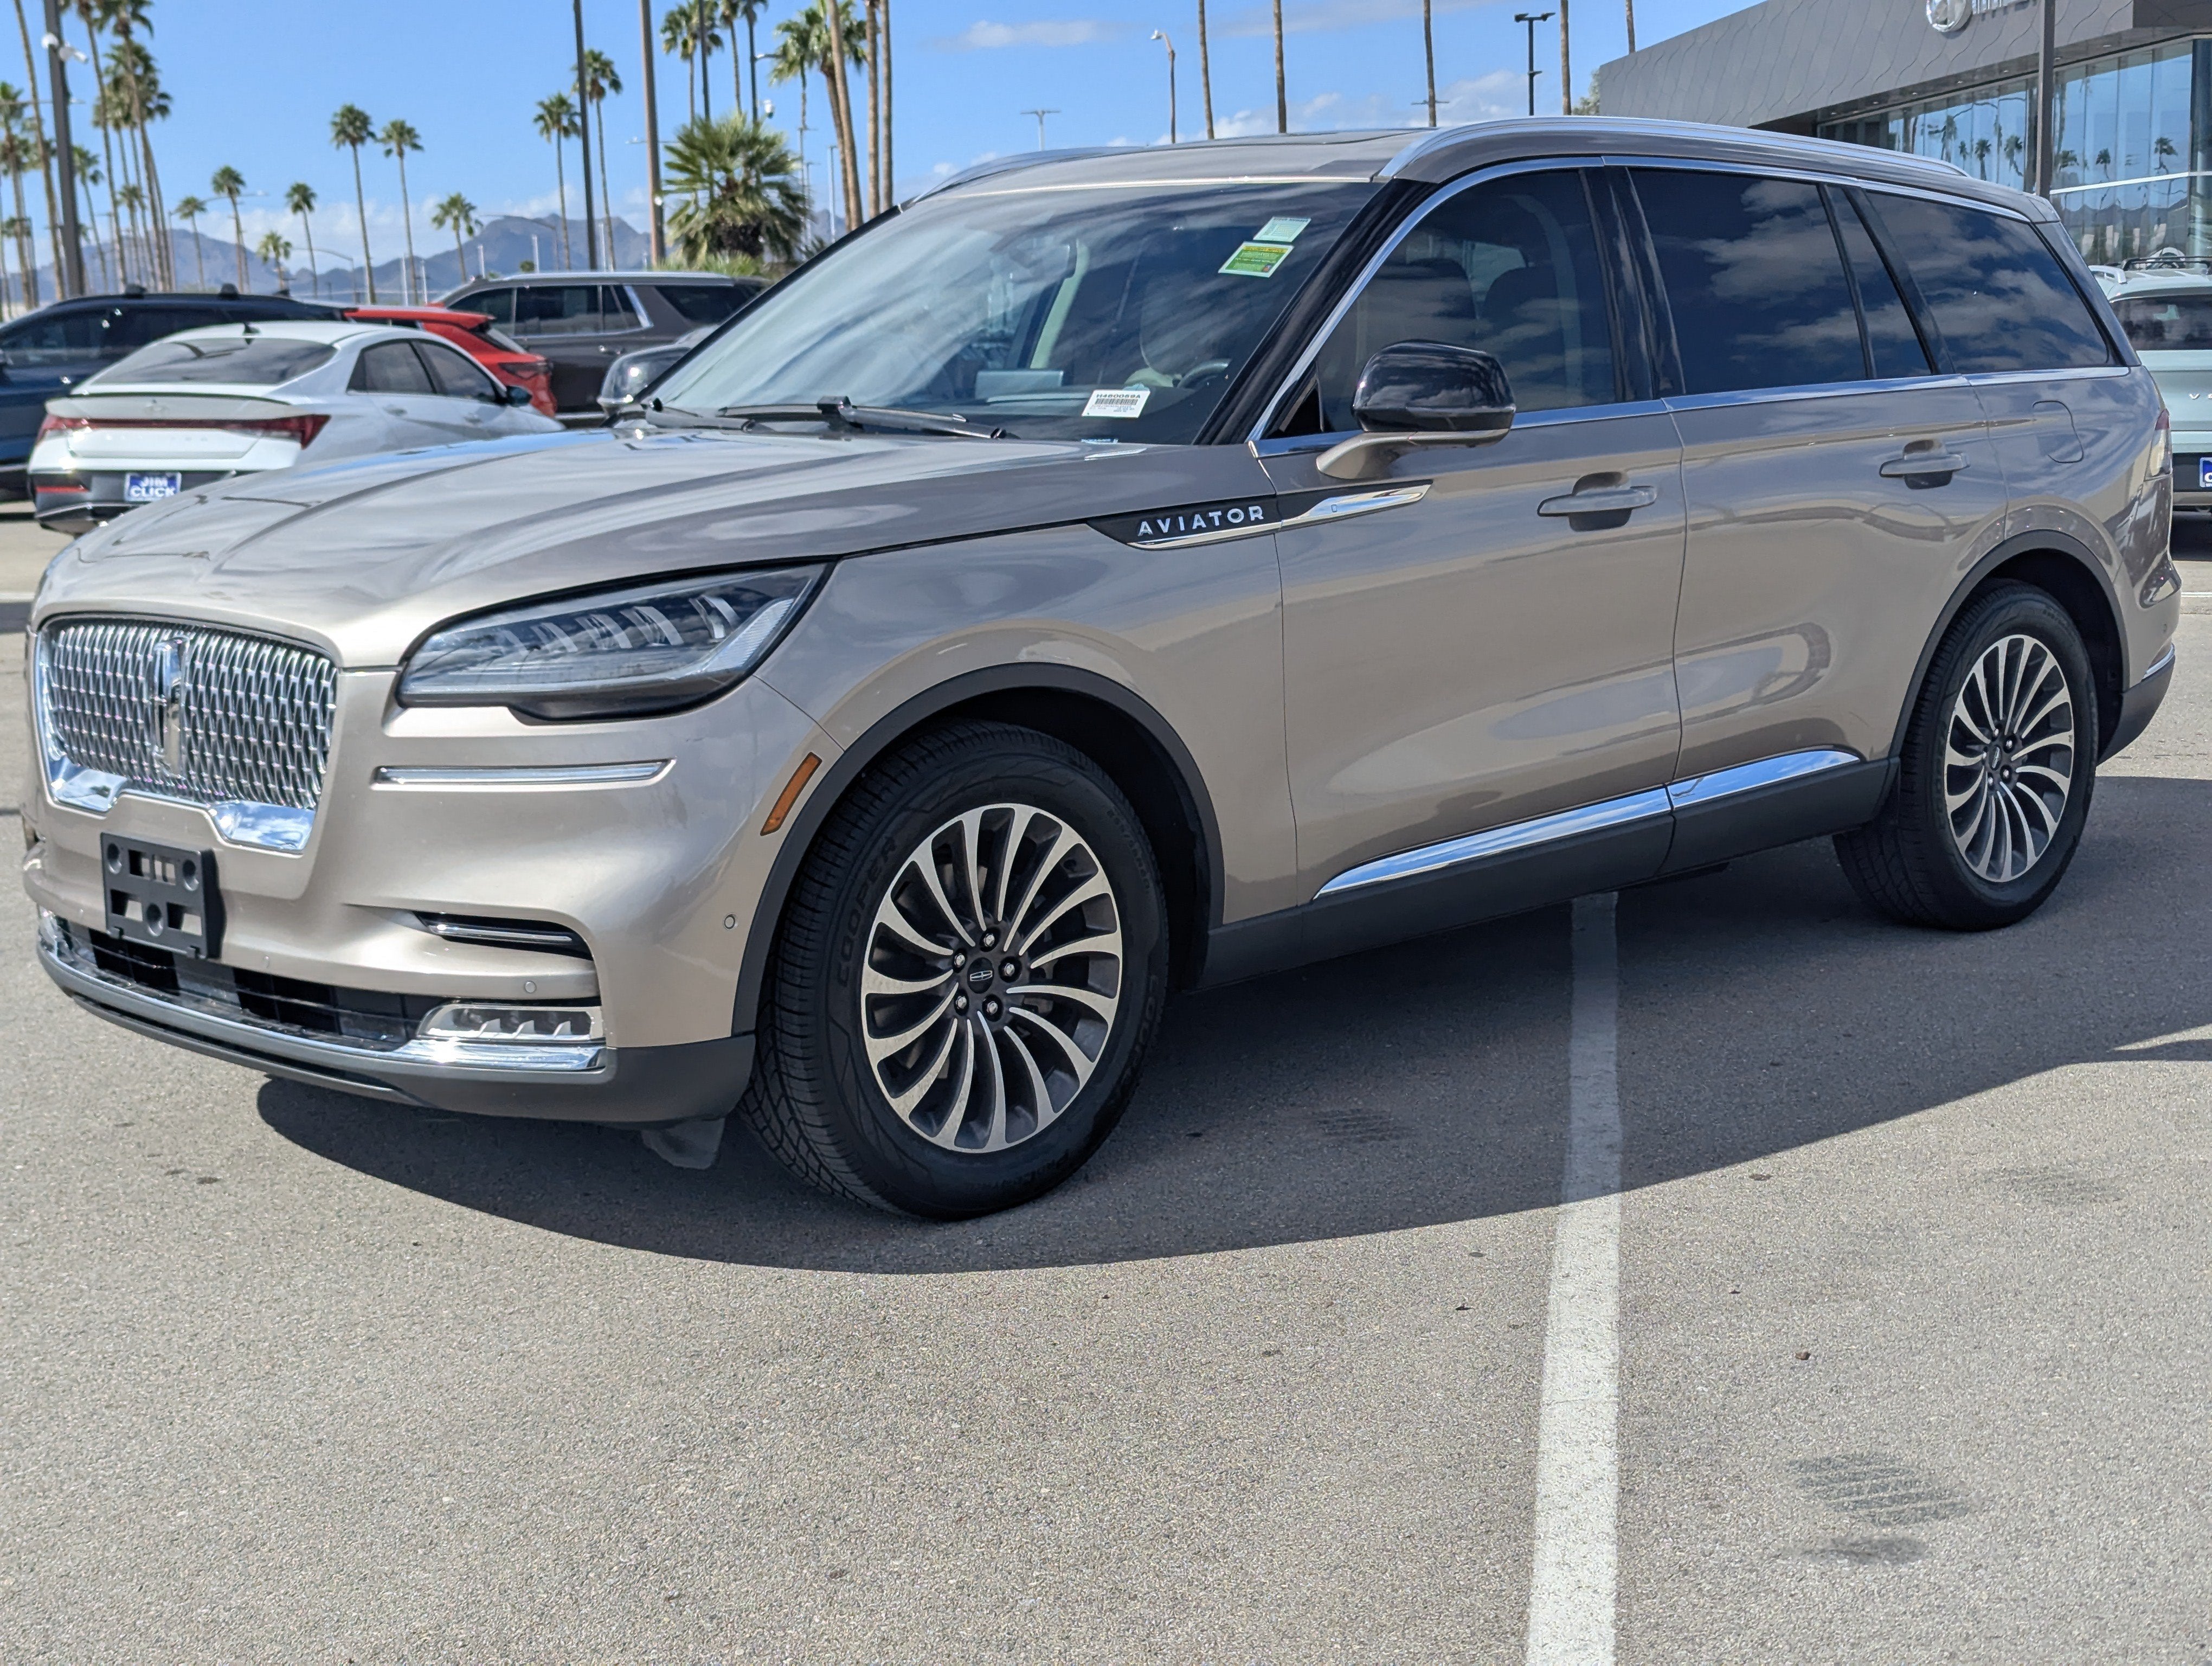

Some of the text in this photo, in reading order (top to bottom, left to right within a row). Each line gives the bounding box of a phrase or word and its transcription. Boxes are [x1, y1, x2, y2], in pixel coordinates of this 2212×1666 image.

[140, 477, 168, 487] JIM
[130, 485, 176, 497] CLICK
[1138, 505, 1264, 537] AVIATOR
